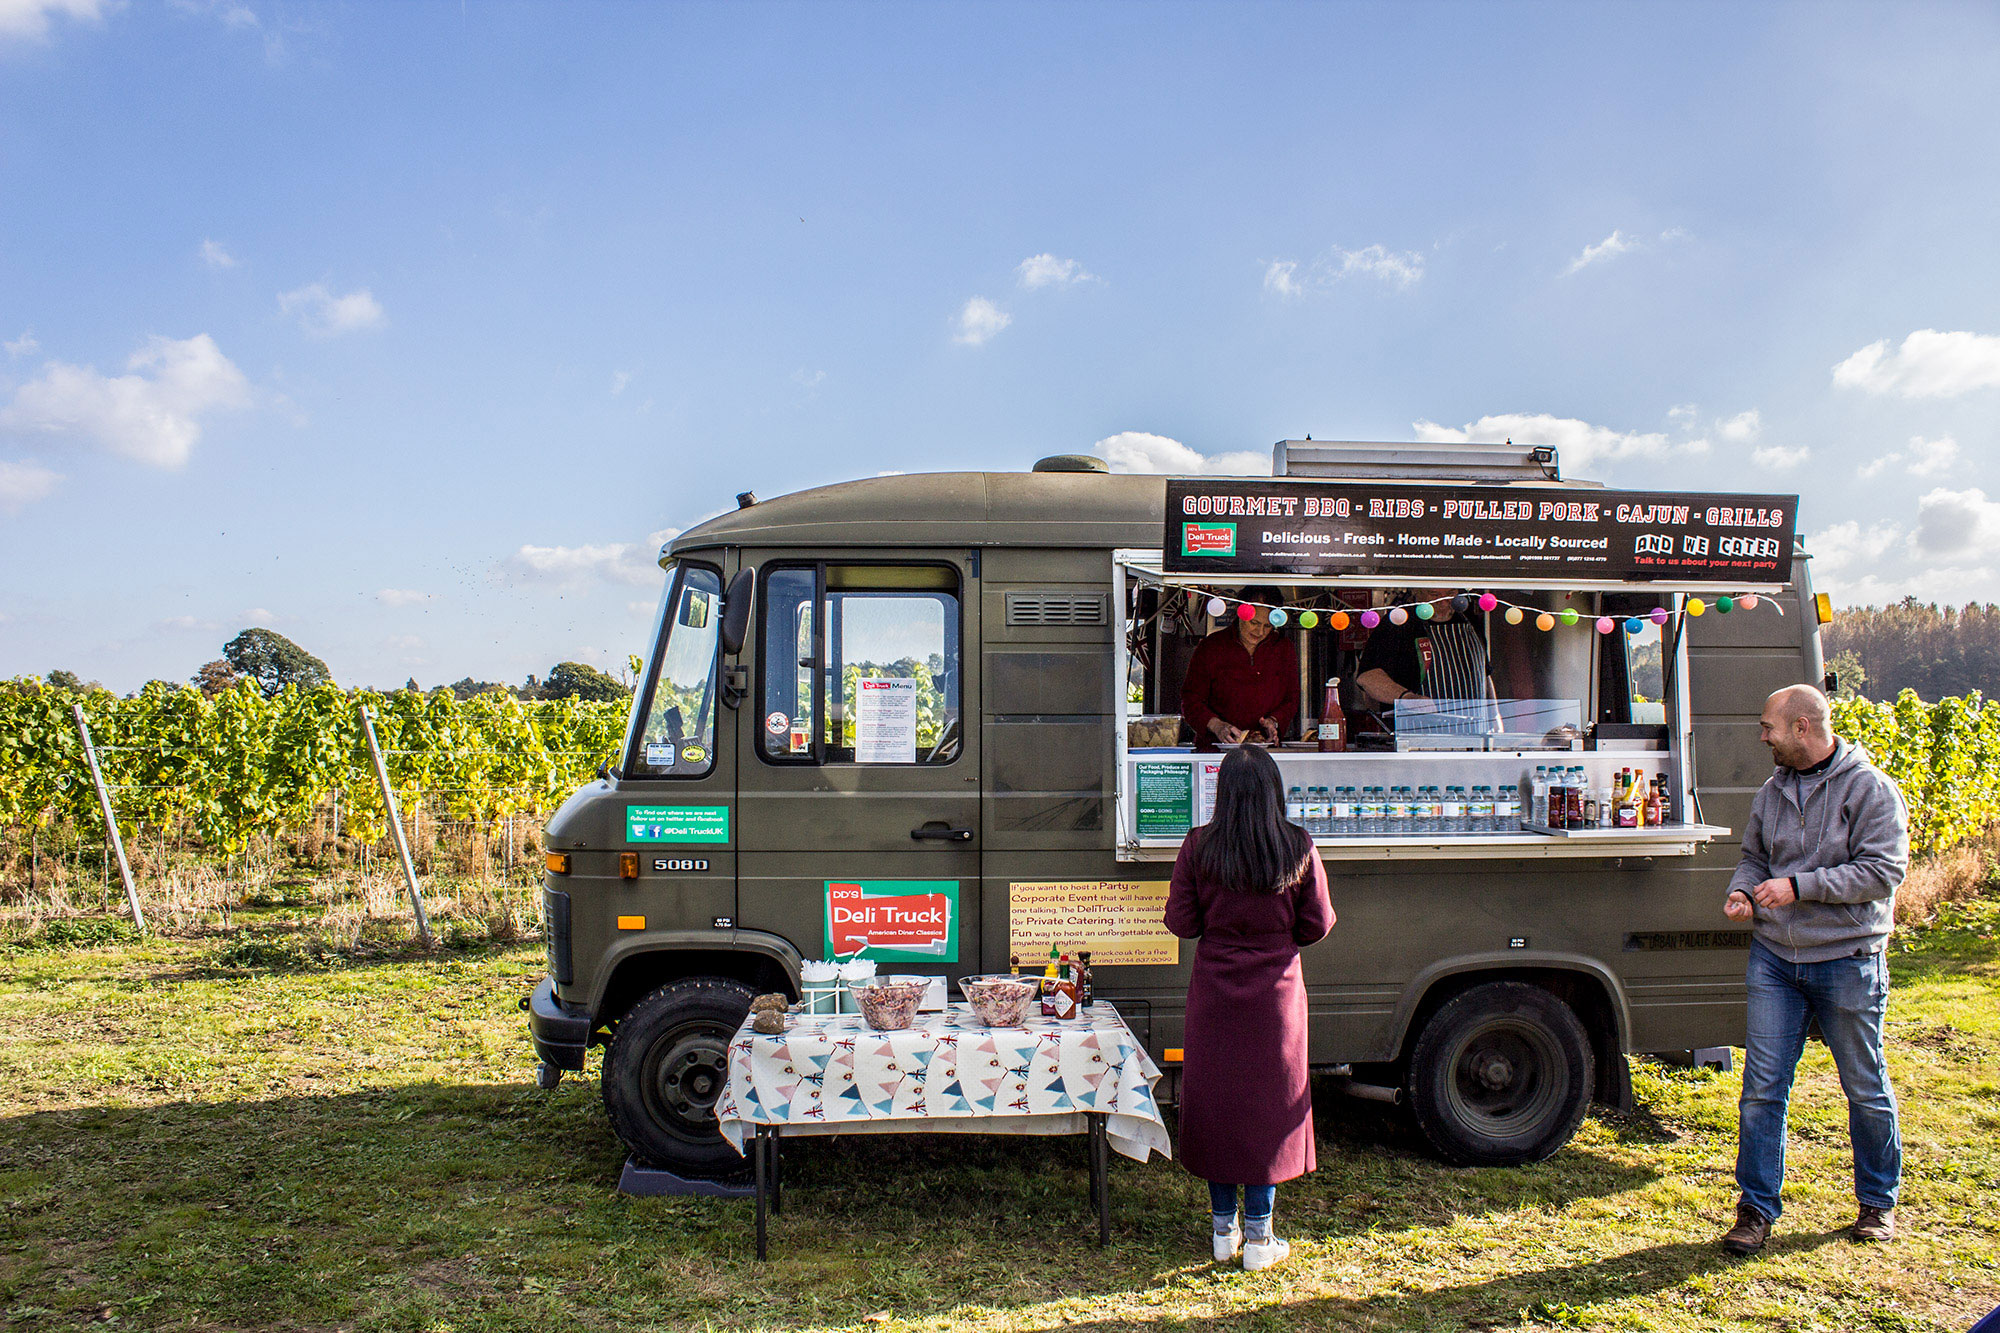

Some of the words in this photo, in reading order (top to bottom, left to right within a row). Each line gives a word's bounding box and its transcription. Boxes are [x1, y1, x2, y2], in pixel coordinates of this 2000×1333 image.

[1182, 496, 1298, 516] GOURMET
[1304, 498, 1350, 518] BBQ
[1369, 499, 1425, 518] RIBS
[1443, 500, 1532, 520] PULLED
[1539, 502, 1599, 521] PORK
[1616, 504, 1689, 524] CAJUN
[1706, 507, 1783, 527] GRILLS
[1187, 533, 1204, 541] Deli
[1206, 533, 1230, 541] Truck
[1262, 531, 1330, 545] Delicious
[1343, 532, 1385, 545] Fresh
[1398, 533, 1439, 546] Home
[1443, 534, 1482, 547] Made
[1495, 535, 1546, 550] Locally
[1550, 536, 1608, 549] Sourced
[1636, 535, 1673, 553] AND
[1684, 536, 1708, 554] WE
[1720, 538, 1778, 556] CATER
[1634, 556, 1654, 565] Talk
[1656, 557, 1666, 565] to
[1681, 558, 1707, 566] about
[1709, 560, 1729, 568] your
[1753, 561, 1777, 570] party
[1099, 881, 1128, 892] Party
[833, 890, 859, 899] DD'S
[1011, 894, 1065, 904] Corporate
[1068, 893, 1098, 901] Event
[1077, 905, 1124, 913] DeliTruck
[834, 907, 876, 923] Deli
[880, 907, 943, 923] Truck
[1026, 917, 1064, 925] Private
[1067, 916, 1116, 926] Catering.
[1011, 929, 1032, 937] Fun
[1097, 929, 1153, 937] unforgettable
[1649, 933, 1677, 949] URBAN
[1680, 932, 1709, 948] PALATE
[1712, 932, 1748, 947] ASSAULT
